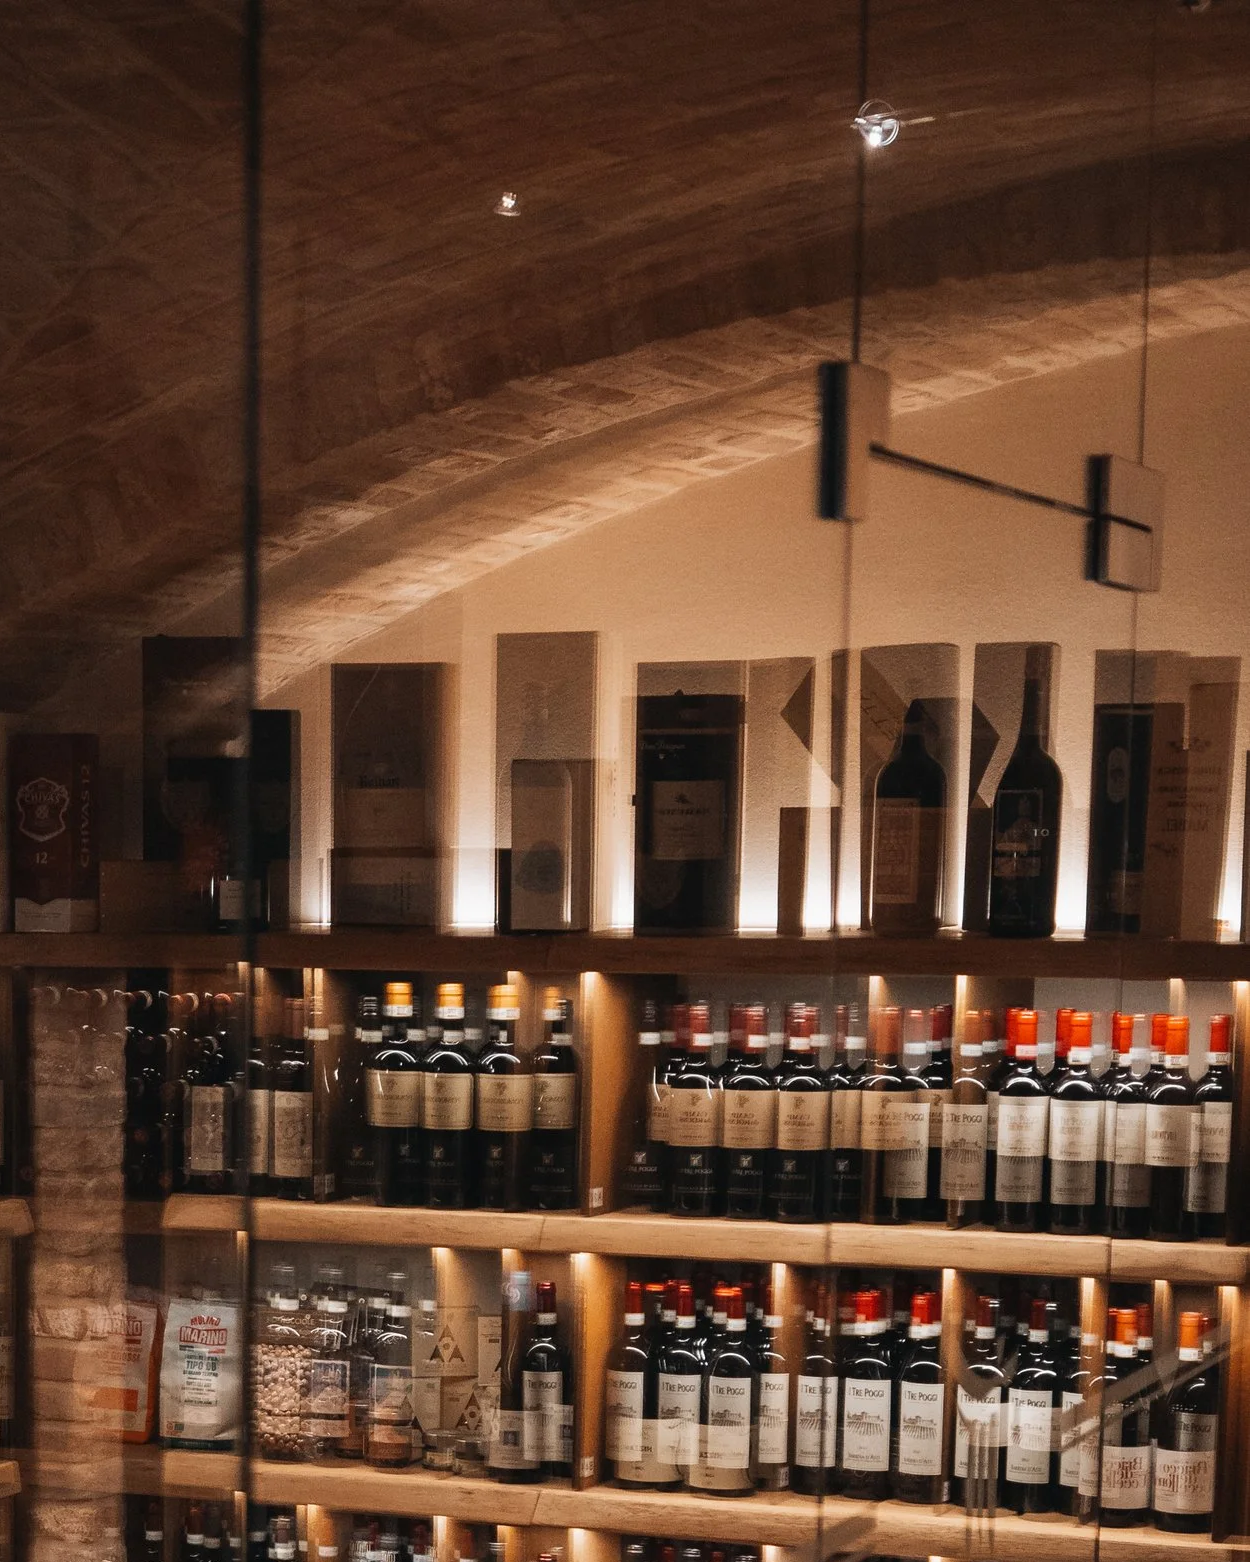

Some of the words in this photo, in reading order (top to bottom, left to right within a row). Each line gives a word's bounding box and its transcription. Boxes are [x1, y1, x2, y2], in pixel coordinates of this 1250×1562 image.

[80, 789, 91, 868] CHIVAS
[35, 852, 48, 864] 12
[962, 1113, 982, 1123] POGGI
[181, 1327, 227, 1345] MARINO
[186, 1361, 203, 1371] TIPO
[666, 1383, 676, 1392] TRE
[677, 1383, 695, 1392] POGGI
[716, 1385, 725, 1394] TRE
[726, 1386, 745, 1395] POGGI
[805, 1384, 816, 1394] TRE
[852, 1387, 863, 1396] TRE
[864, 1387, 884, 1397] POGGI
[907, 1391, 917, 1400] TRE
[918, 1391, 937, 1402] POGGI
